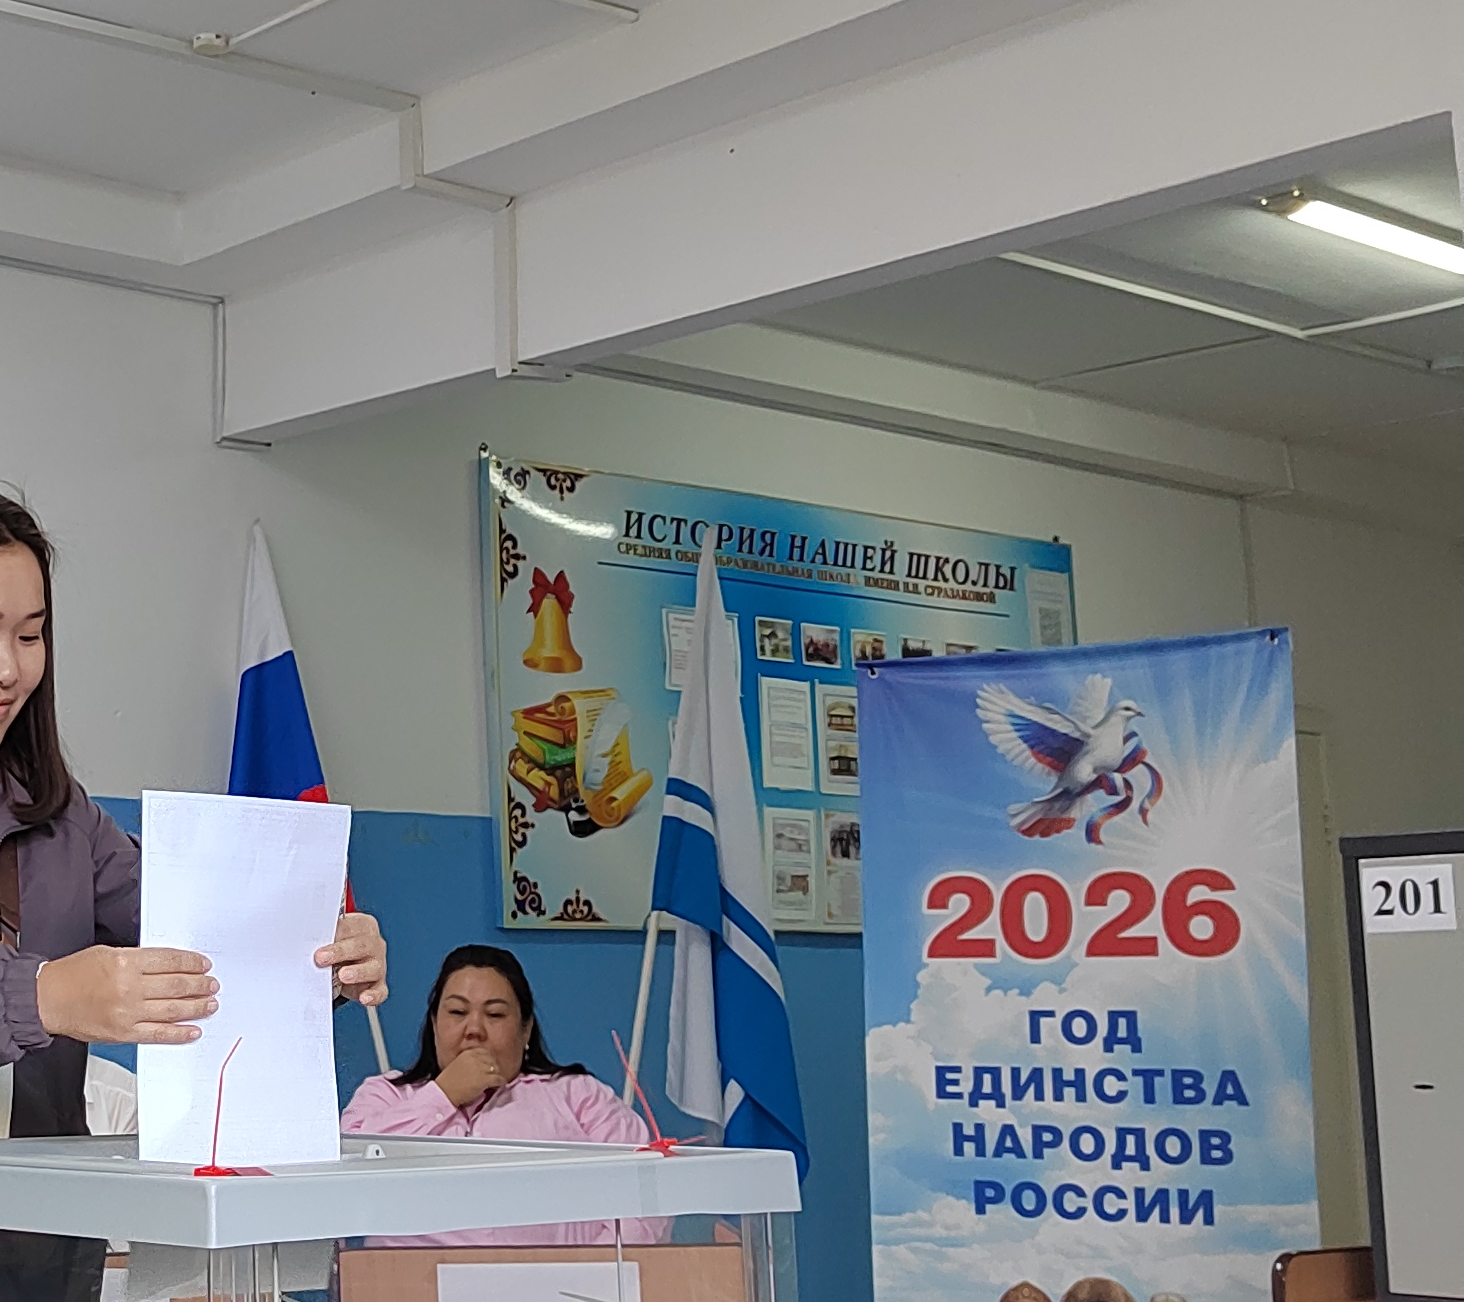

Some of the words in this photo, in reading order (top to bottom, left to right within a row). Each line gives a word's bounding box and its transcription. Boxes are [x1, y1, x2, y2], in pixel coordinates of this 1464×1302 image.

[617, 541, 672, 561] СРЕДНЯЯ
[675, 550, 814, 580] ОБЩОБРАЗОВАТЕЛЬНАЯ
[864, 575, 901, 592] ИМЕНИ
[622, 509, 778, 559] ИСТОРИЯ
[786, 533, 898, 576] НАШЕЙ
[905, 551, 1018, 592] ШКОЛЫ
[926, 869, 1241, 959] 2026
[1371, 878, 1448, 917] 201
[1028, 1009, 1142, 1053] ГОД
[935, 1065, 1250, 1108] ЕДИНСТВА
[951, 1122, 1235, 1172] НАРОДОВ
[973, 1179, 1216, 1227] РОССИИ
